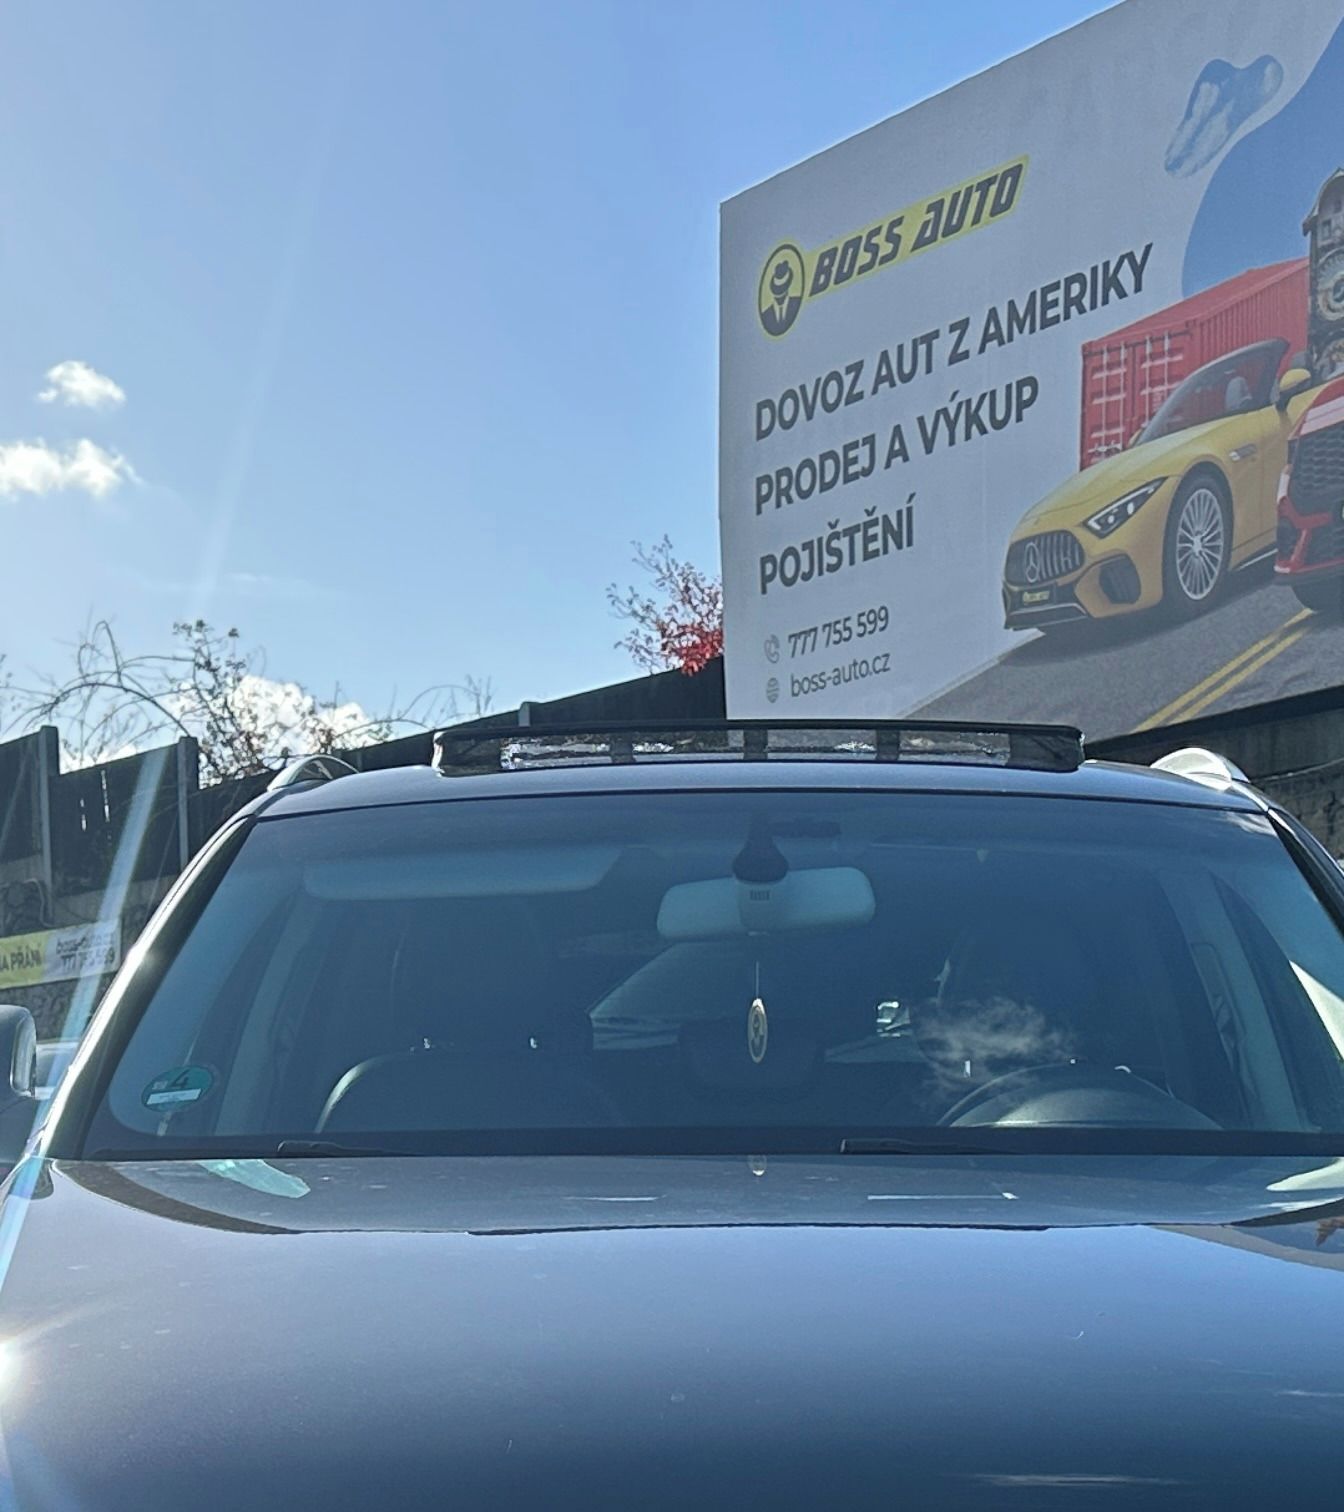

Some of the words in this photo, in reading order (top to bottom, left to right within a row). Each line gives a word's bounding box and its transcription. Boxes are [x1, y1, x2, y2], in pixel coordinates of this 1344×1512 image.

[809, 216, 905, 298] BOSS
[910, 163, 1023, 253] AUTO
[756, 360, 864, 441] DOVOZ
[871, 329, 940, 395] AUT
[947, 317, 970, 366] Z
[977, 242, 1154, 355] AMERIKY
[756, 433, 876, 516] PRODEJ
[884, 424, 910, 470] A
[916, 376, 1039, 455] VÝKUP
[760, 492, 916, 595] POJIŠTĚNÍ
[787, 626, 818, 658] 777
[822, 616, 852, 648] 755
[856, 606, 889, 638] 599
[790, 653, 891, 697] boss-auto.cz
[171, 1068, 191, 1088] 4
